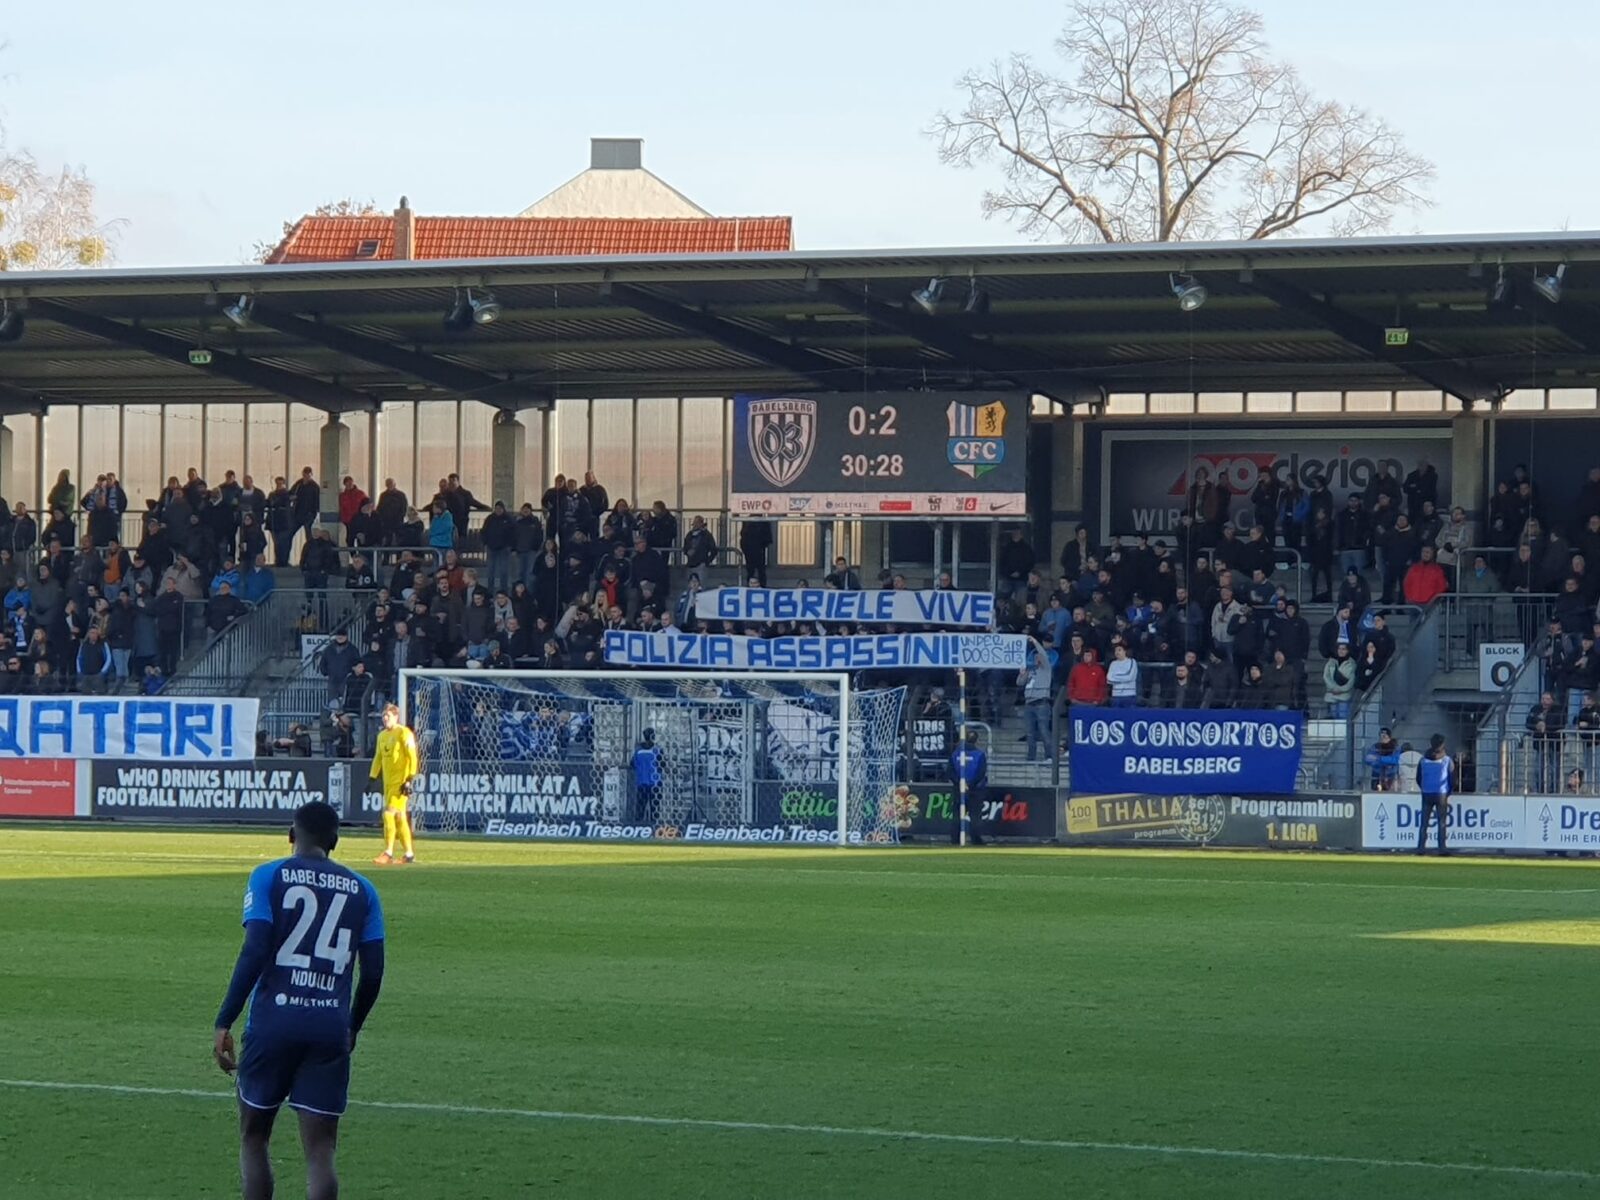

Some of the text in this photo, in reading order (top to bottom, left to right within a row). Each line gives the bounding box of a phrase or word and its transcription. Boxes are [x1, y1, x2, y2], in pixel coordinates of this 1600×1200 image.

[753, 403, 812, 412] BABELSBERG
[849, 405, 897, 435] 0:2
[759, 421, 804, 462] 03
[953, 441, 997, 460] CFC
[841, 454, 903, 476] 30:28
[741, 501, 761, 510] EWP
[719, 589, 993, 624] GABRIELE VIVE
[306, 638, 330, 646] BLOC
[604, 631, 959, 667] POLIZIA ASSASSINI!
[961, 634, 1003, 647] UNDER
[1485, 647, 1520, 655] BLOCK
[962, 646, 1003, 665] DOGS
[1073, 720, 1296, 749] LOS CONSORTOS
[1124, 756, 1241, 775] BABELSBERG
[118, 768, 307, 790] WHO DRINKS MILK AT A
[429, 773, 491, 793] DRINKS
[495, 774, 540, 794] MILK
[541, 775, 566, 795] AT
[567, 776, 581, 795] A
[97, 786, 176, 806] FOOTBALL
[179, 788, 236, 808] MATCH
[446, 793, 506, 813] MATCH
[510, 796, 597, 816] ANYWAY?
[782, 790, 874, 817] Glücs
[1231, 796, 1355, 818] Programmkino
[1071, 805, 1091, 818] 100
[1102, 796, 1183, 822] THALIA
[1561, 805, 1600, 831] Dre
[486, 818, 580, 838] Eisenbach
[584, 821, 653, 839] Tresore
[685, 823, 784, 842] Eisenbach
[787, 825, 861, 844] Tresoe
[1134, 829, 1177, 839] programm
[1266, 823, 1318, 842] 1. LIGA
[1490, 819, 1513, 828] GmbH
[1396, 831, 1415, 840] IHR
[1560, 834, 1600, 843] IHR ER
[281, 868, 359, 894] BABELSBERG
[275, 885, 352, 975] 24
[289, 996, 340, 1009] MIETHKE
